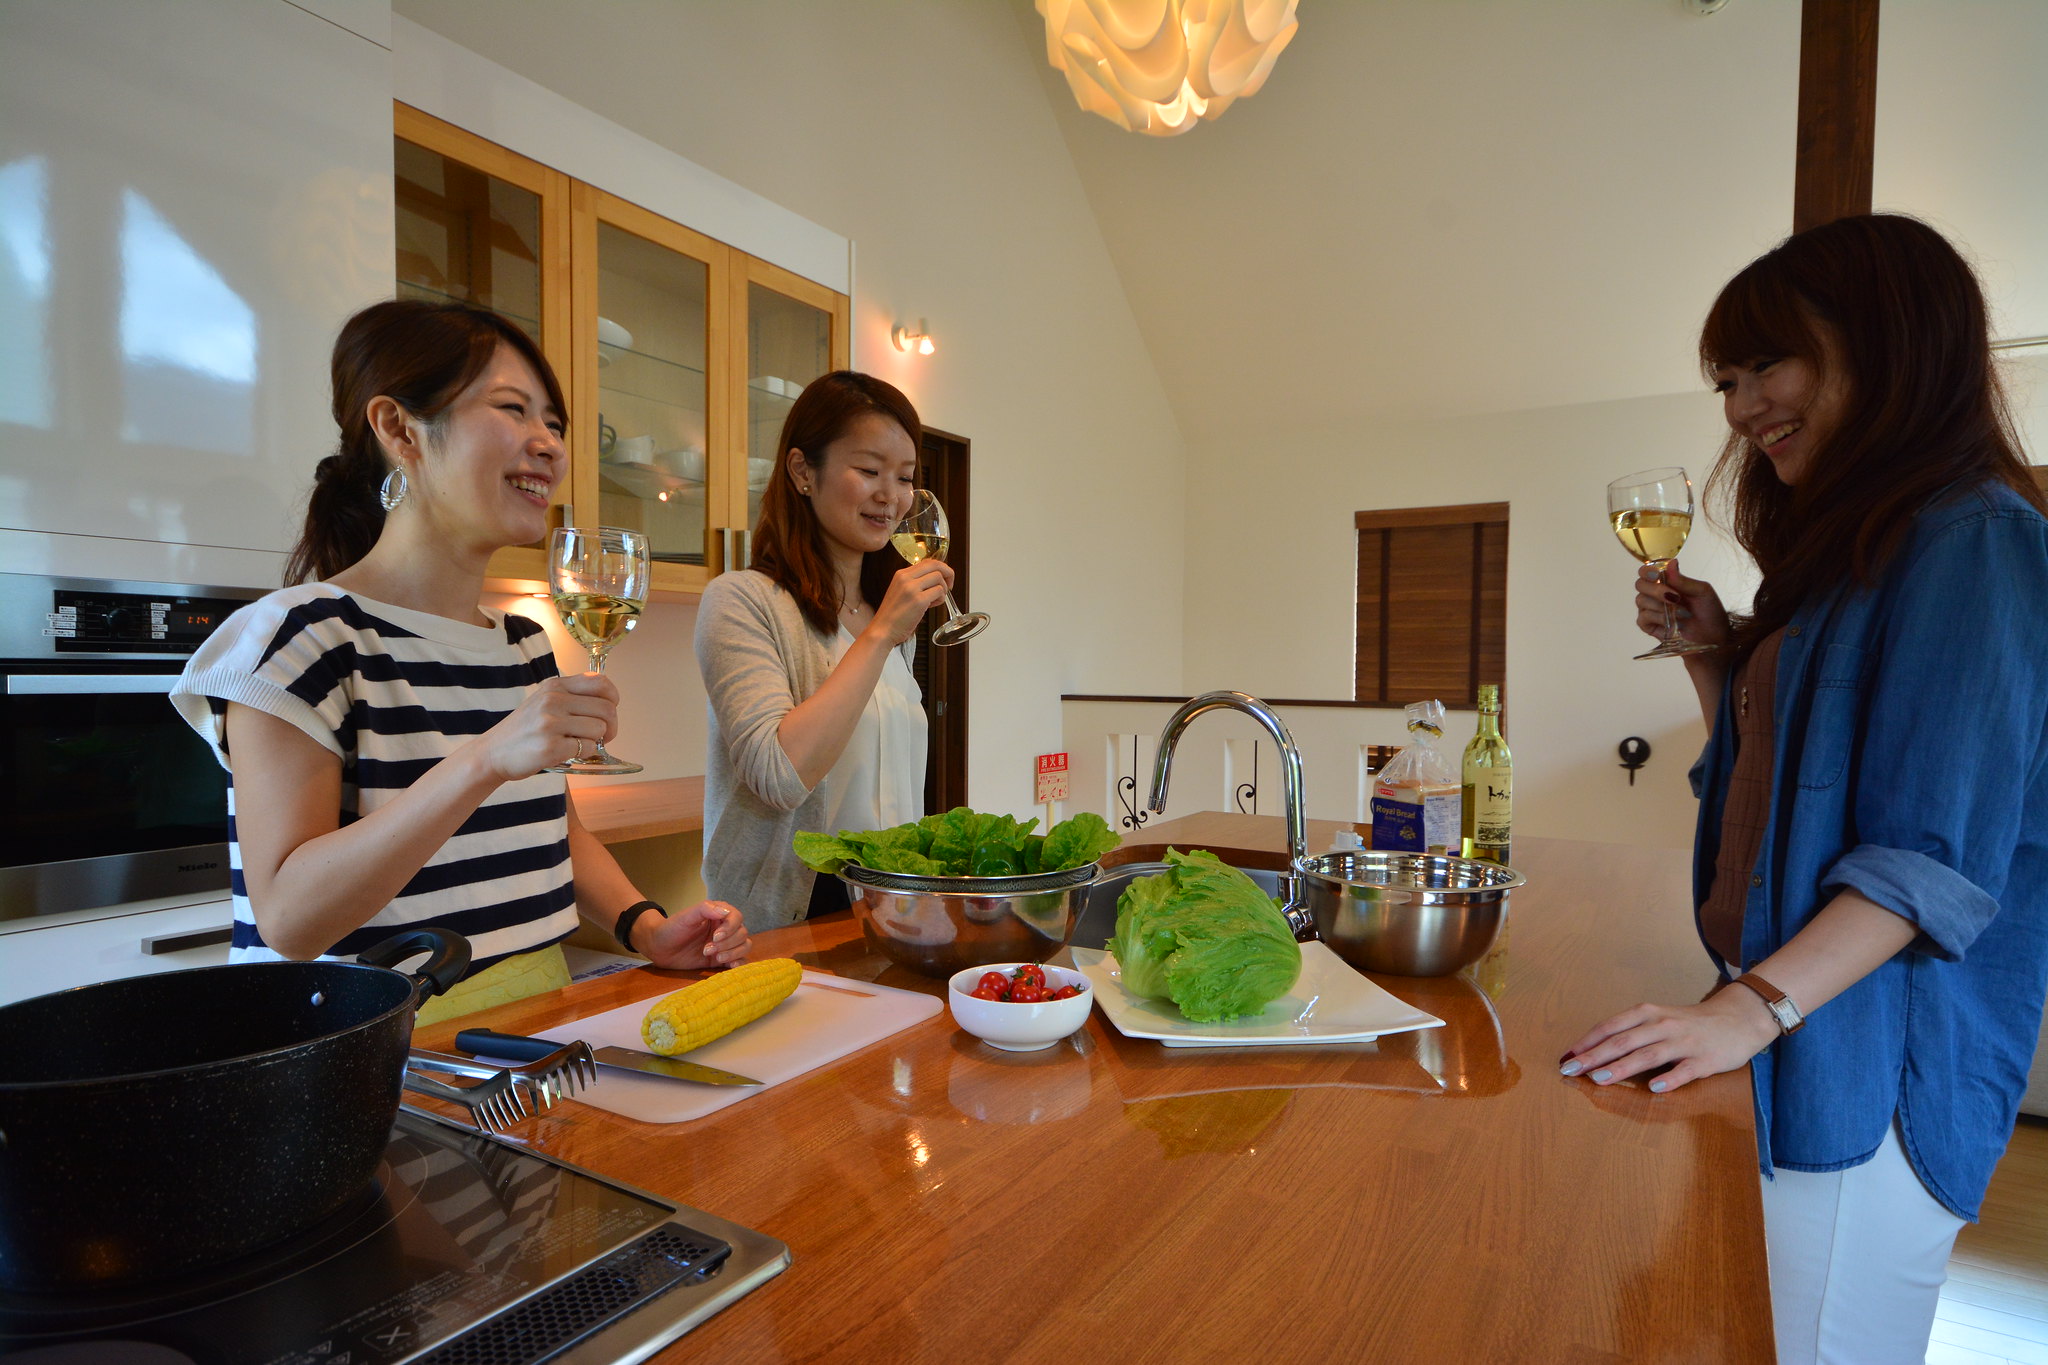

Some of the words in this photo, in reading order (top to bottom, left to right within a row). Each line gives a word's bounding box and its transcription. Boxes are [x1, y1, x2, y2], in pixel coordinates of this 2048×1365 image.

[1041, 755, 1065, 768] 消火器
[1376, 804, 1395, 816] Royal
[1396, 808, 1416, 819] Bread
[178, 862, 217, 873] Miele
